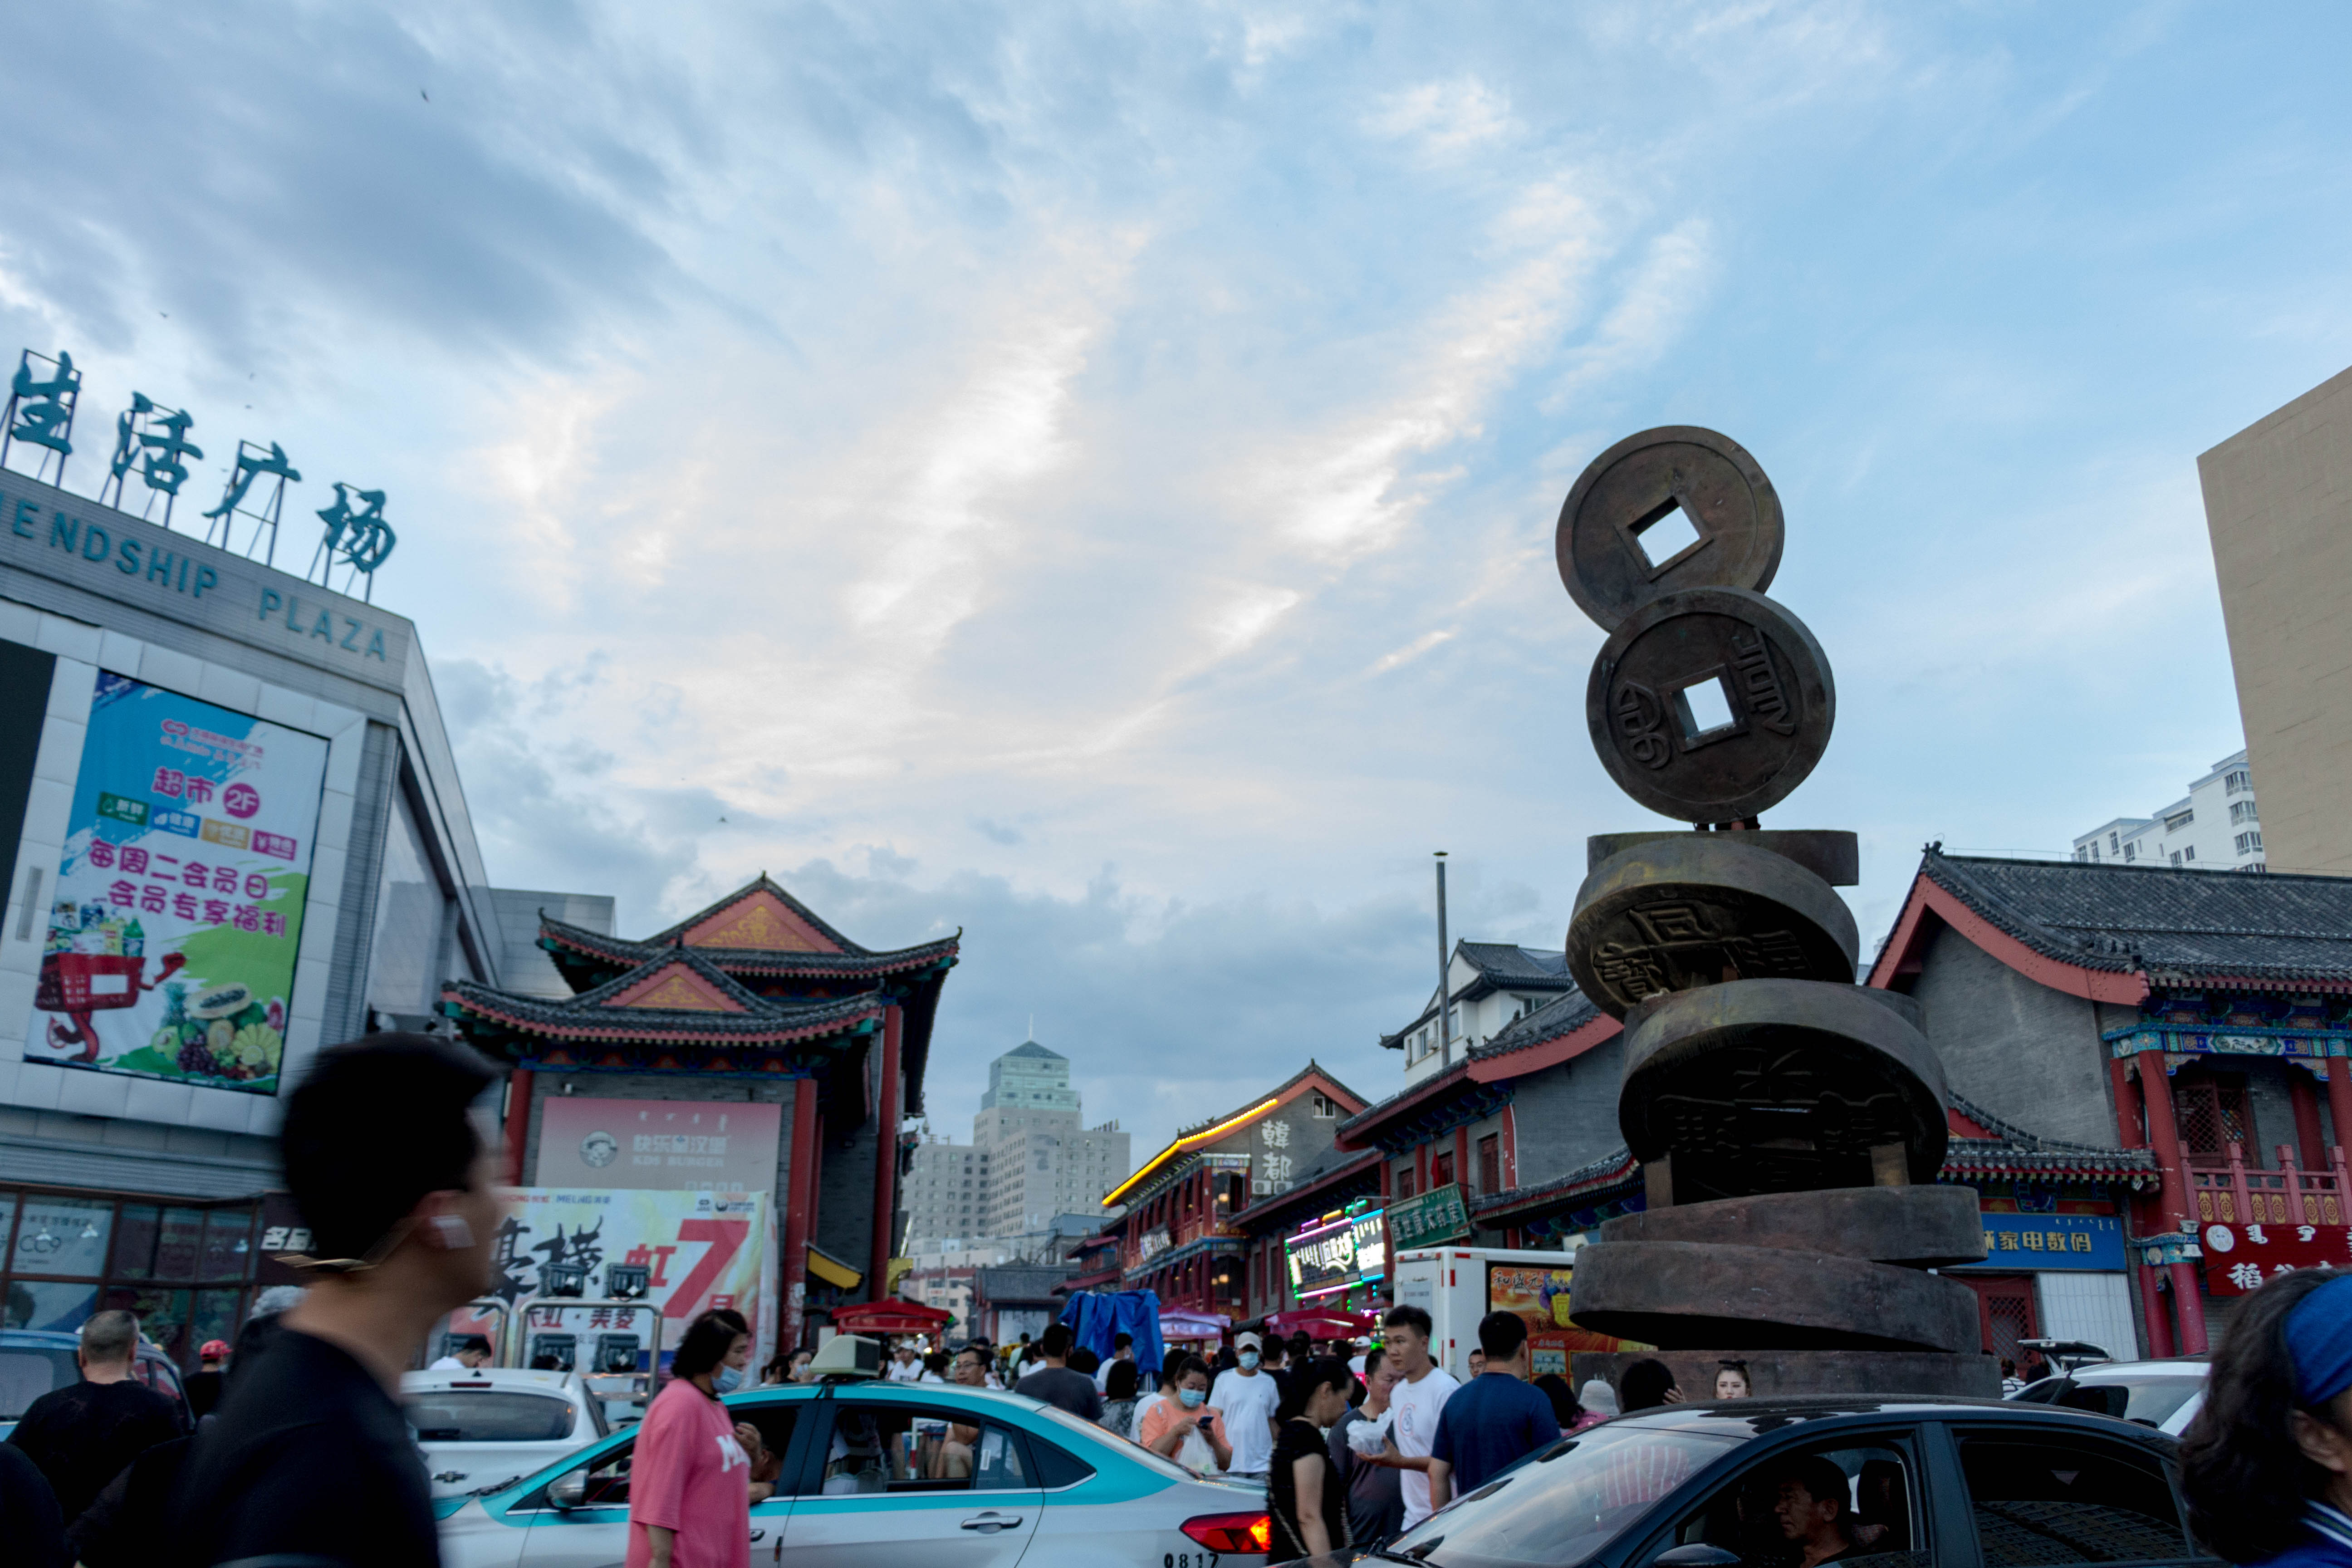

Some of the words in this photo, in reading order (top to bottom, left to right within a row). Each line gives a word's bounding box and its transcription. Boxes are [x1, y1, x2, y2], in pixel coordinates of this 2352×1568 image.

[11, 350, 397, 573] 生活广场
[258, 588, 386, 662] PLAZA
[151, 766, 216, 804] 超市
[225, 789, 258, 812] 2F
[88, 838, 268, 901] 每周二会员日
[108, 879, 286, 938] 会员专享福利
[668, 1156, 725, 1167] BURGER
[1163, 1553, 1220, 1568] 0817
